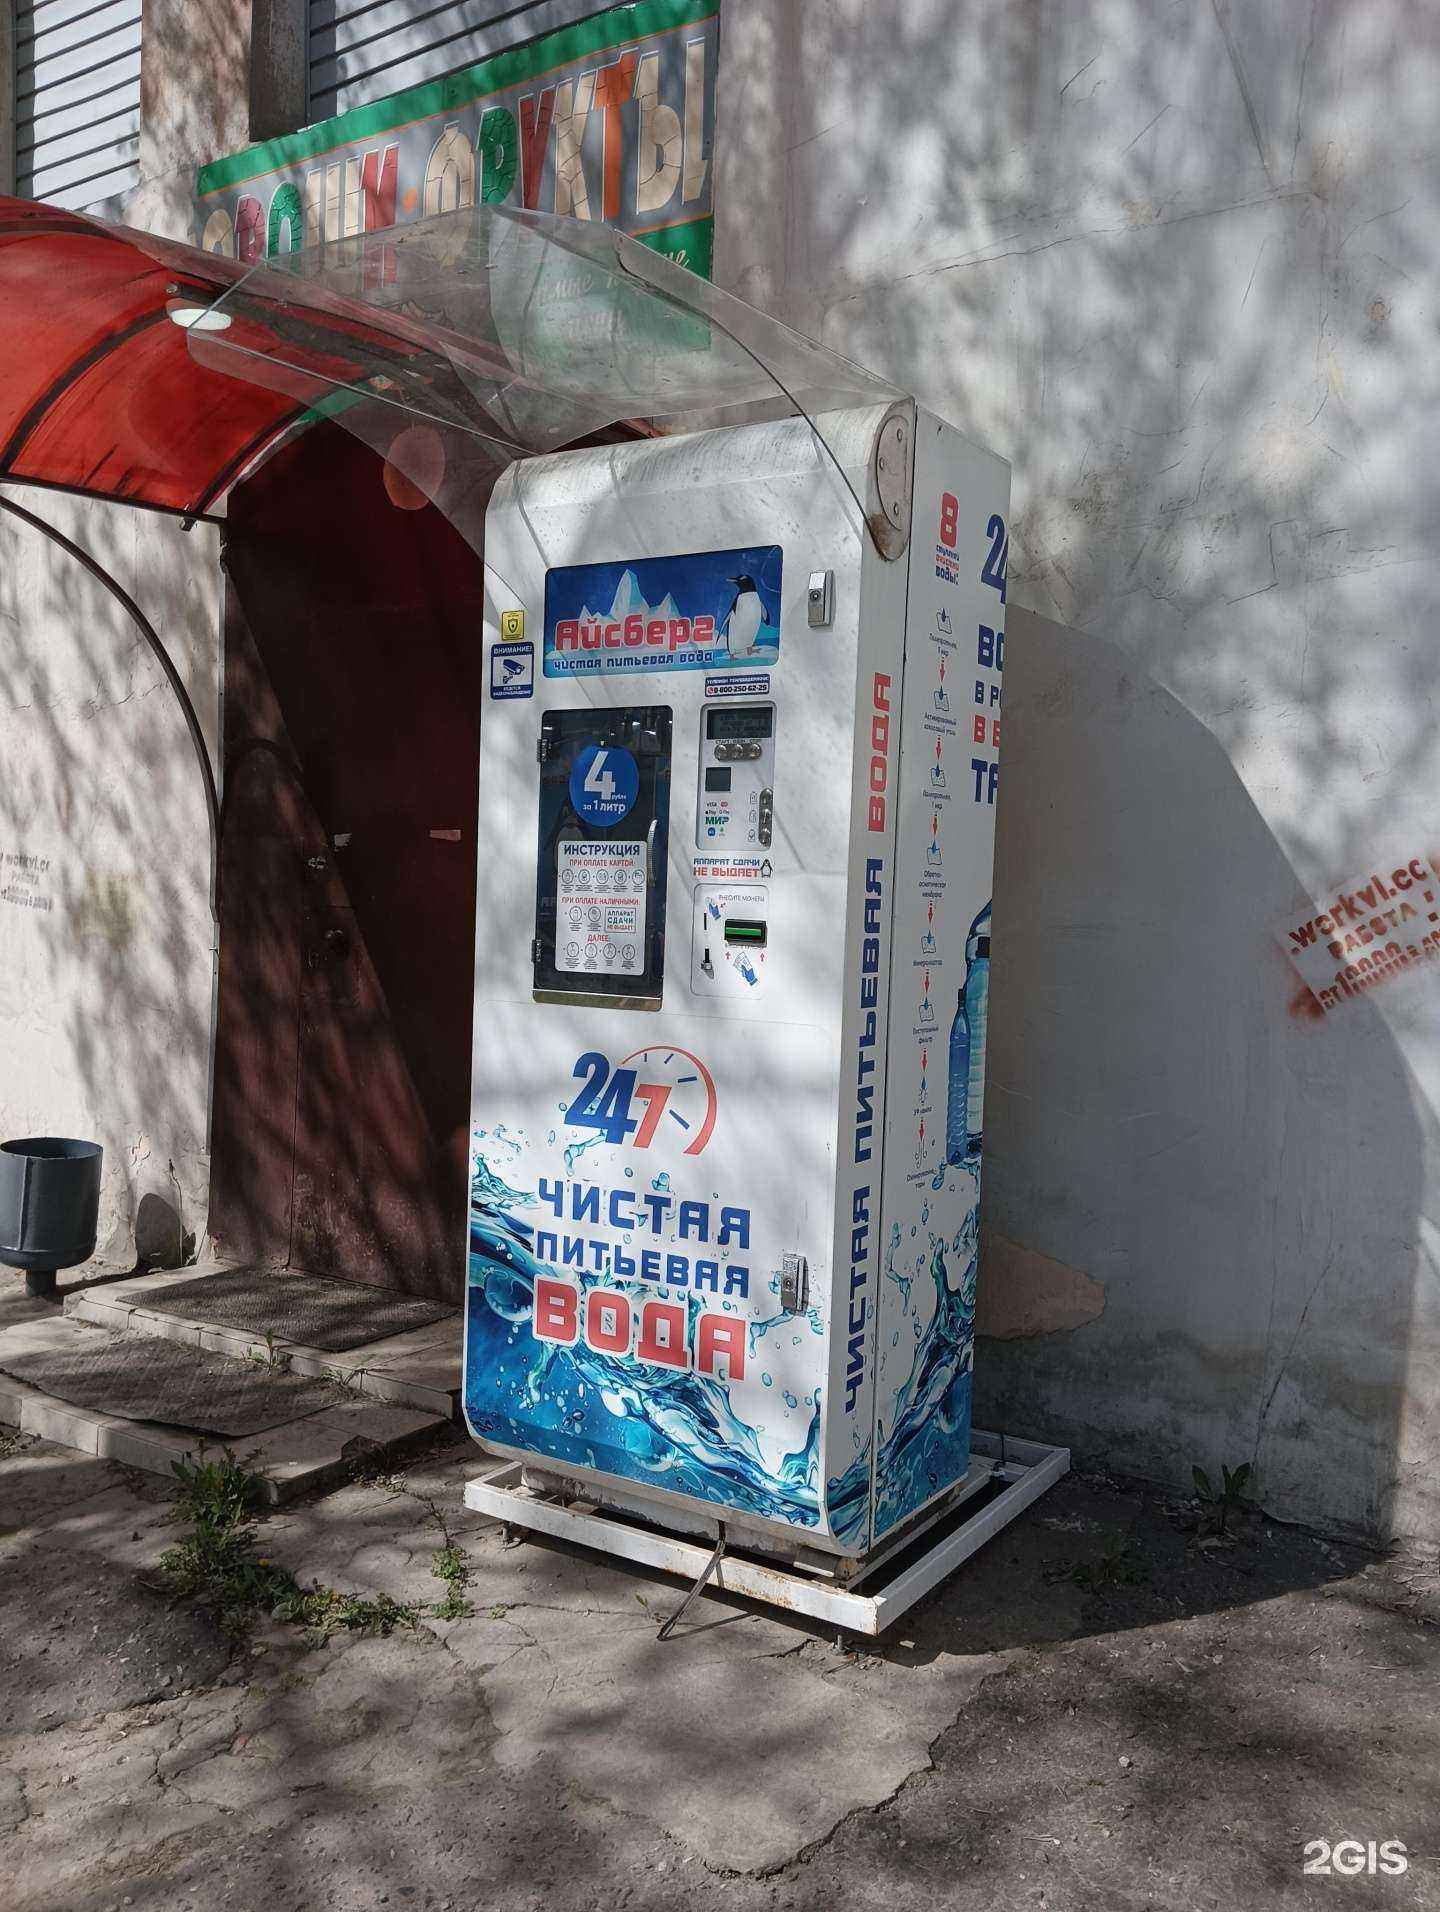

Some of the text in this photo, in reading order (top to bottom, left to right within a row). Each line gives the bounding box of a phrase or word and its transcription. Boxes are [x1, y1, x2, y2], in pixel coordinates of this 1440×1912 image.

[940, 492, 959, 548] 8
[555, 614, 716, 652] Айсберг
[552, 649, 714, 671] чистая питьевая вода
[583, 750, 616, 800] 4
[593, 800, 598, 811] 1
[599, 802, 626, 814] литр
[705, 816, 730, 825] МИР
[564, 844, 640, 857] ИНСТРУКЦИЯ
[693, 857, 760, 867] АППАРАТ СДАЧИ
[693, 866, 760, 878] НЕ ВЫДАЕТ
[844, 671, 892, 1414] ЧИСТАЯ ПИТЬЕВАЯ ВОДА
[537, 1177, 751, 1251] ЧИСТАЯ
[536, 1230, 750, 1299] ПИТЬЕВАЯ
[534, 1278, 747, 1383] ВОДА
